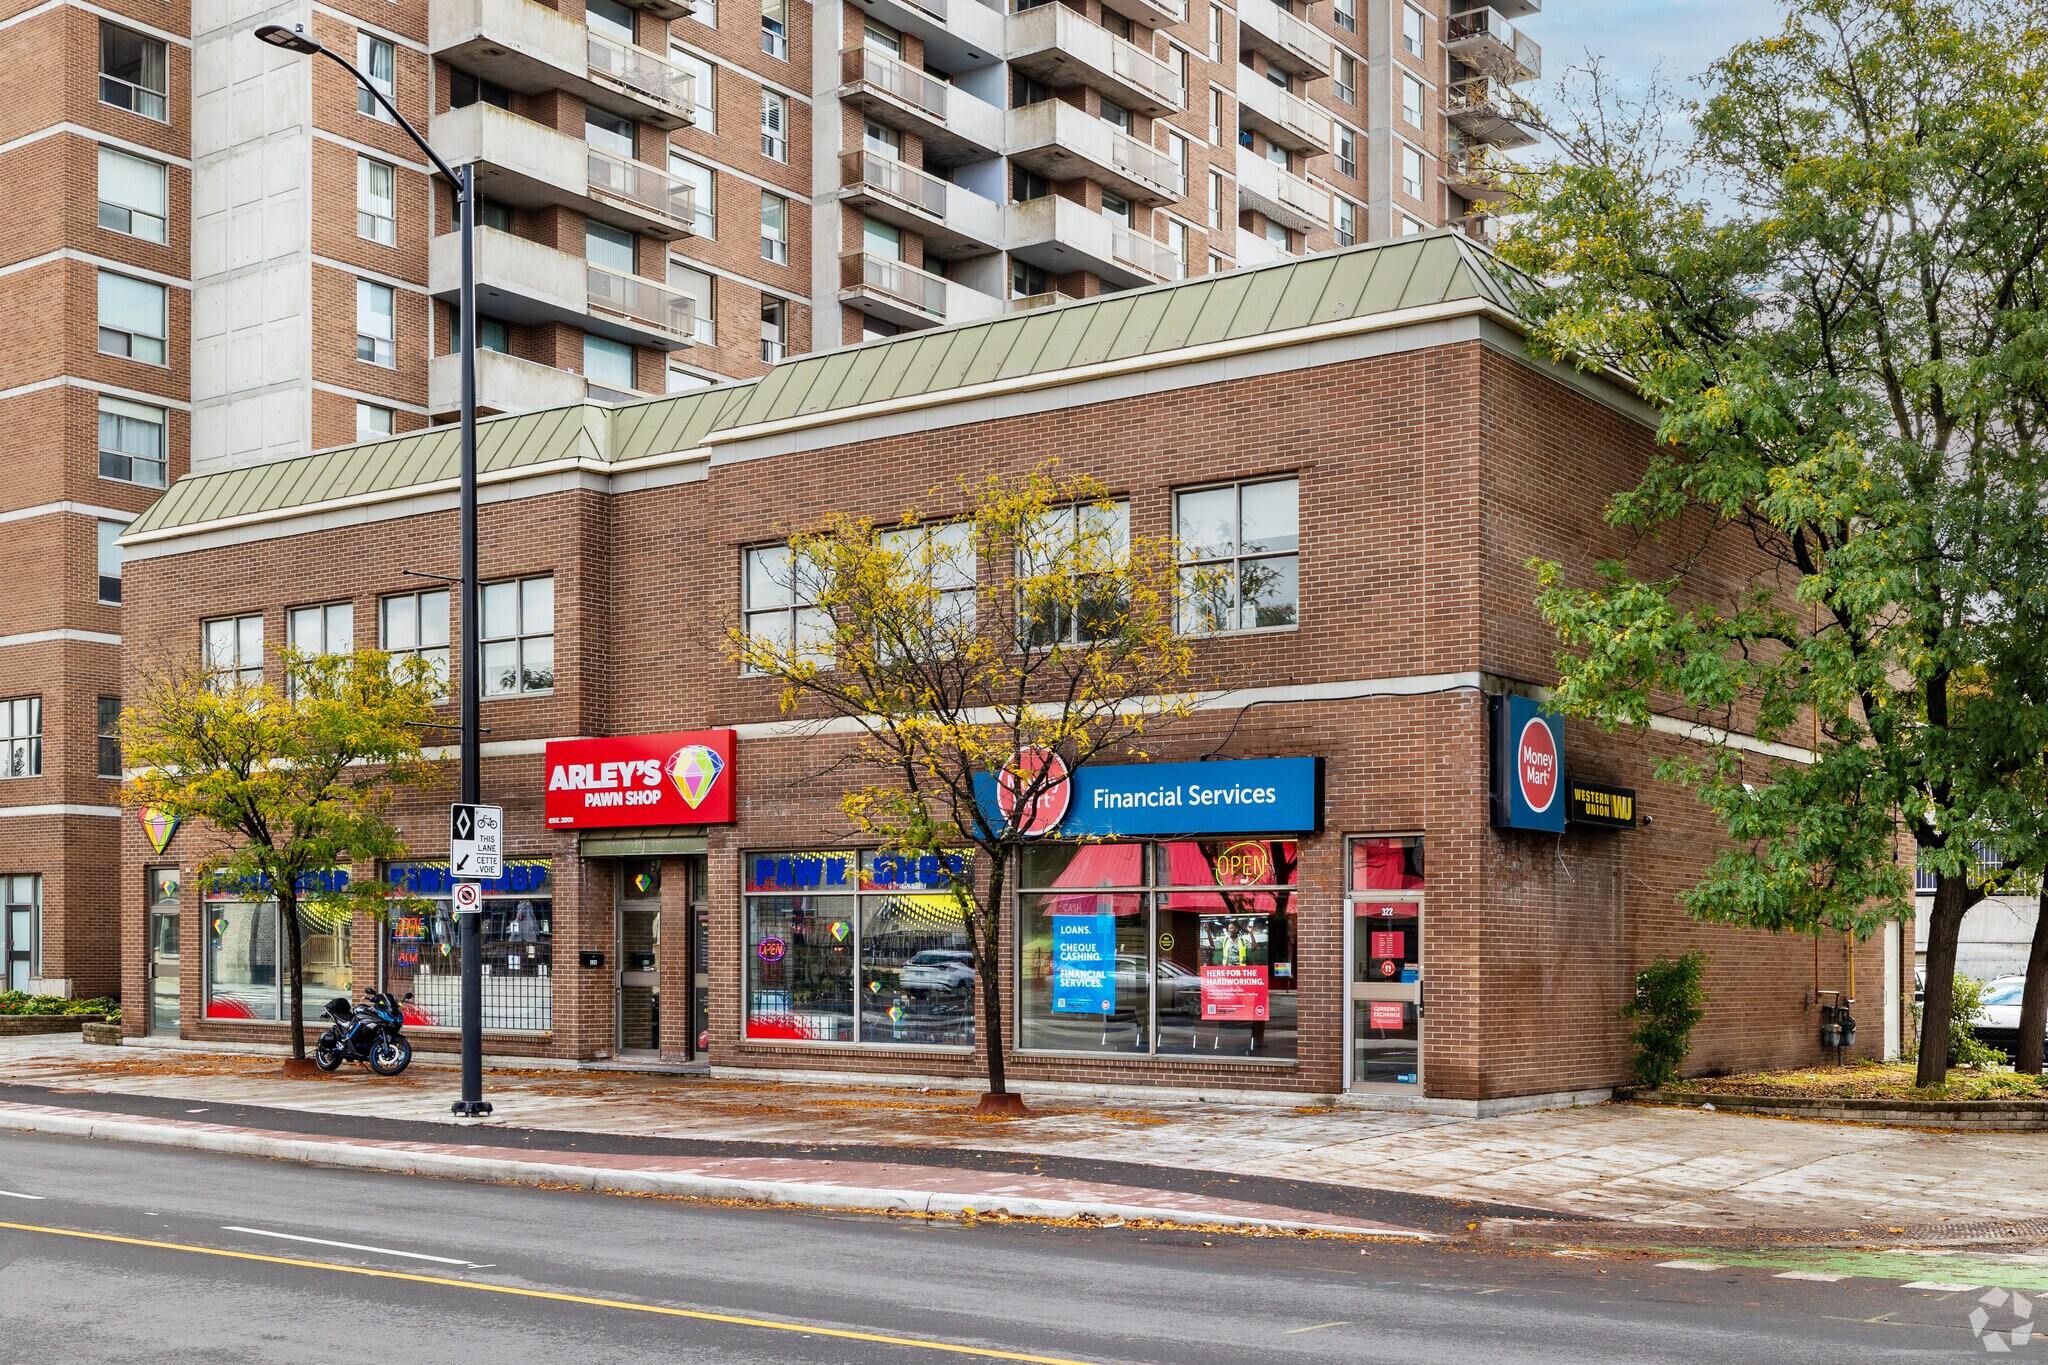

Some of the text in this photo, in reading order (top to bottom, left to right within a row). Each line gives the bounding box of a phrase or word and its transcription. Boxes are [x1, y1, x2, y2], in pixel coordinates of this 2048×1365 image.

[1523, 745, 1553, 771] Money
[548, 759, 662, 791] ARLEY'S
[584, 789, 662, 807] PAWN SHOP
[1094, 783, 1276, 809] Financial Services
[1573, 788, 1610, 805] WESTERN
[1585, 803, 1610, 817] UNION
[480, 835, 495, 843] THIS
[478, 844, 496, 852] LANE
[1217, 855, 1265, 876] OPEN
[756, 858, 848, 886] PAWN
[1382, 908, 1393, 916] 322
[1060, 926, 1091, 934] LOANS.
[759, 943, 783, 955] OPEN
[1060, 943, 1097, 952] CHEQUE
[1060, 952, 1102, 961] CASHING.
[1060, 970, 1106, 979] FINANCIAL
[1206, 969, 1257, 977] HERE FOR THE
[1060, 979, 1103, 988] SERVICES.
[1206, 978, 1265, 986] HARDWORKING.
